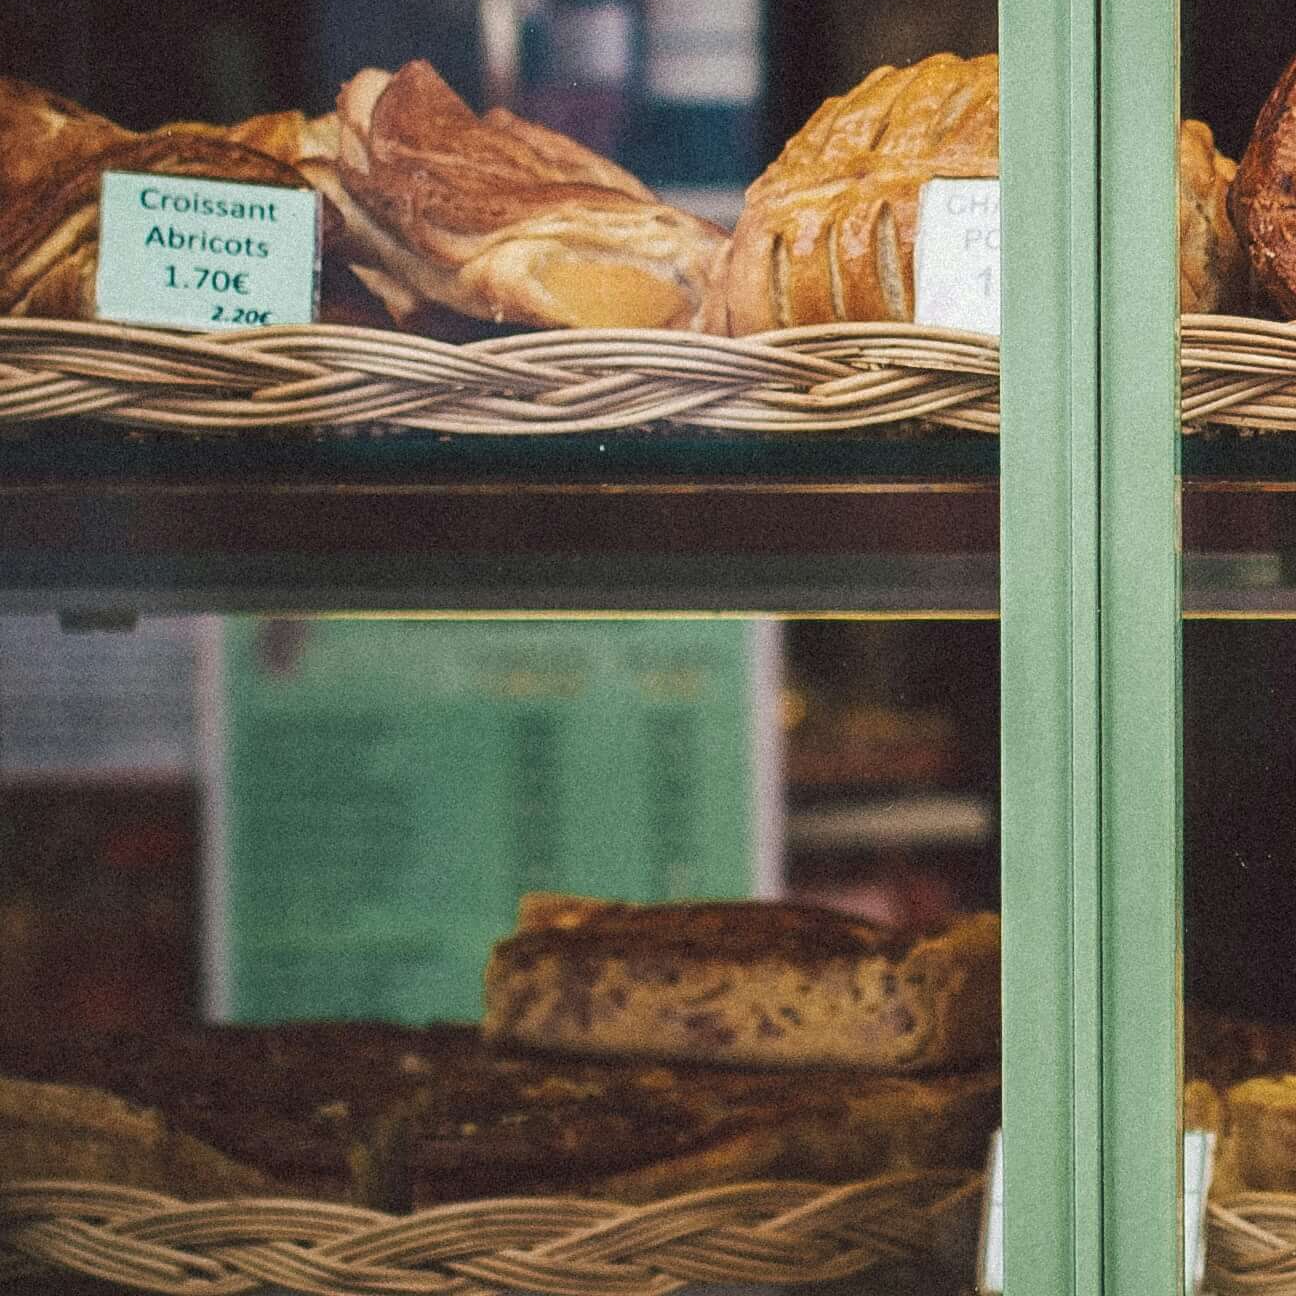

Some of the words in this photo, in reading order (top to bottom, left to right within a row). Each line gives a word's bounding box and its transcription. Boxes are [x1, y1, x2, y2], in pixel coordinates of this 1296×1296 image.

[140, 187, 278, 222] Croissant
[946, 193, 1000, 216] CH
[144, 224, 270, 258] Abricots
[165, 264, 249, 295] 1.70€
[211, 306, 273, 325] 2.20€
